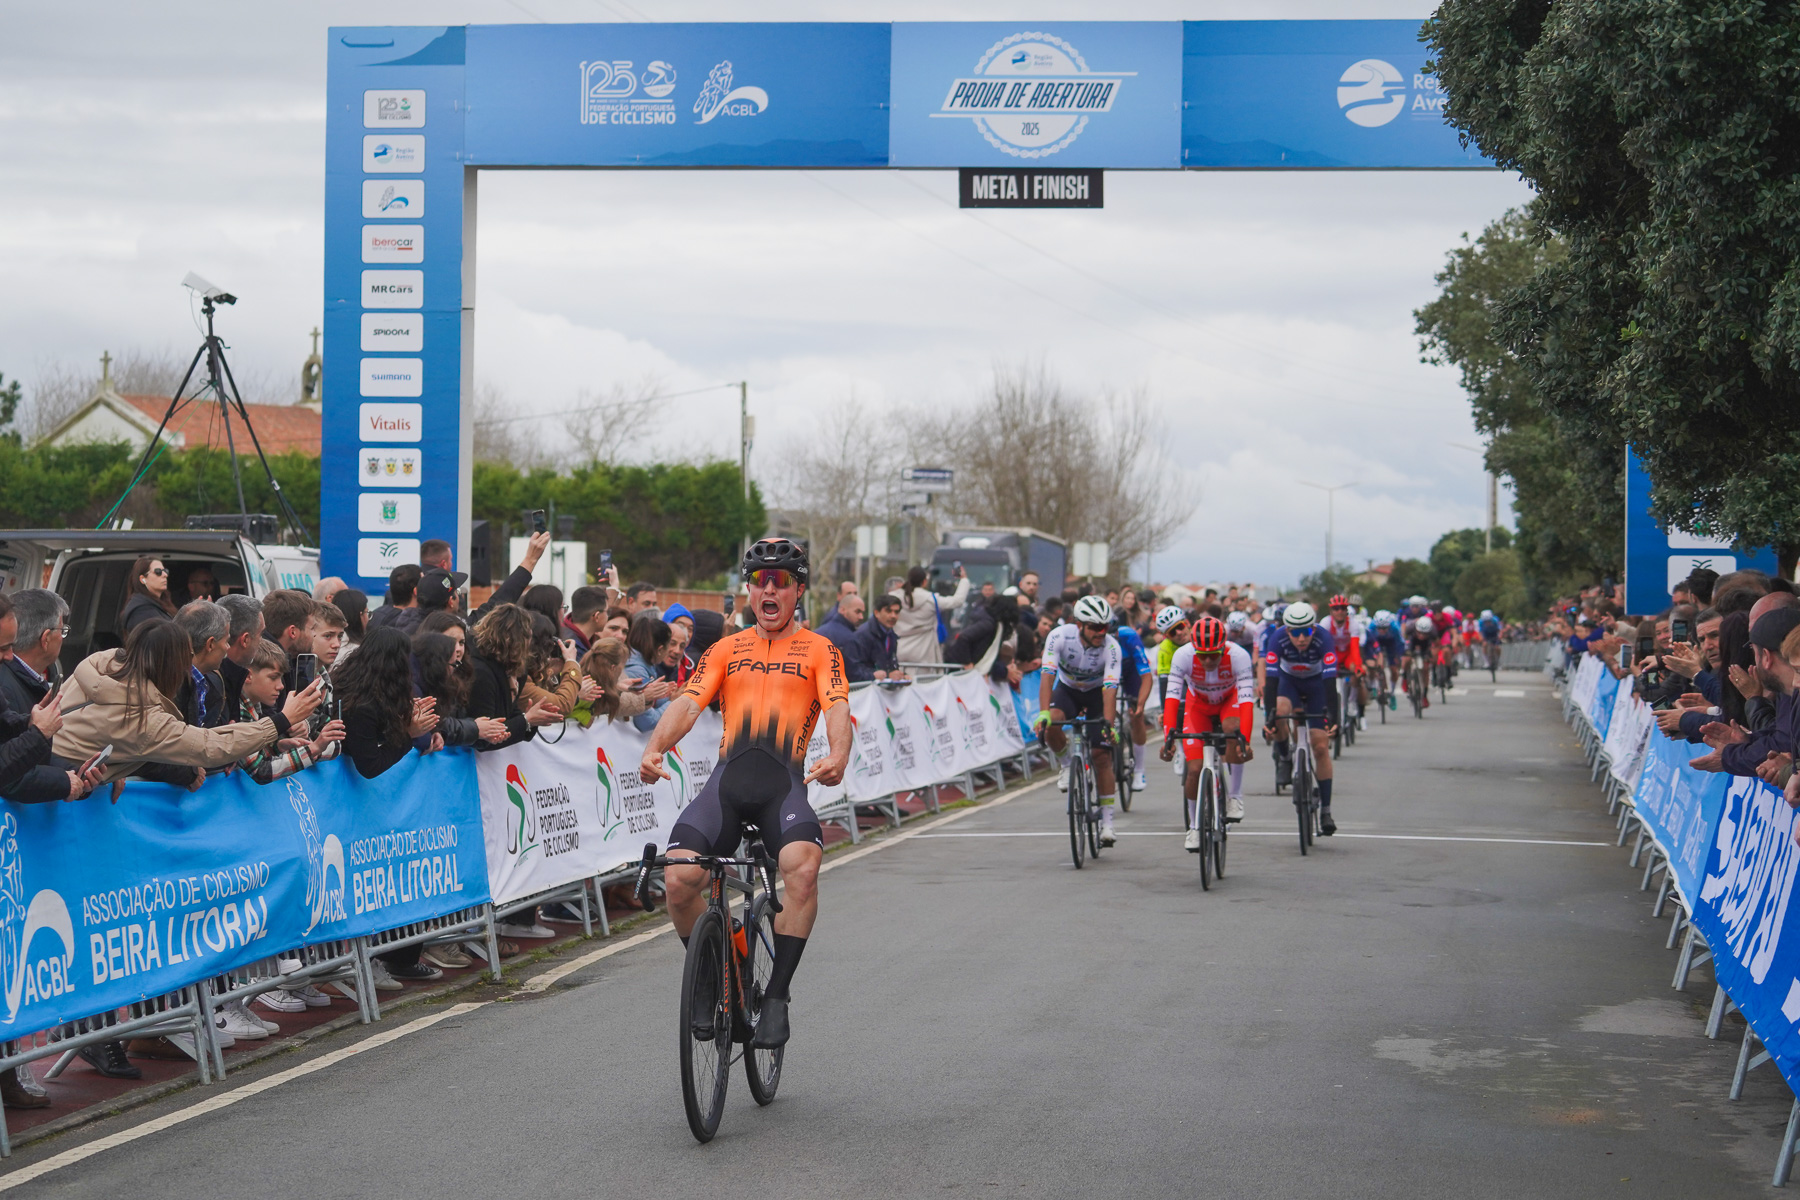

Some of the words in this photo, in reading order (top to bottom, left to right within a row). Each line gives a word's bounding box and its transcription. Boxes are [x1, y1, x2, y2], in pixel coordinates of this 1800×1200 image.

[589, 104, 629, 112] FEDERAÇÃO
[630, 104, 675, 112] PORTUGUESA
[949, 82, 1007, 108] PROVA
[1004, 82, 1031, 108] DE
[1027, 82, 1115, 108] ABERTURA
[1411, 94, 1448, 111] Ave
[589, 112, 607, 124] DE
[611, 112, 676, 124] CICLISMO
[721, 104, 757, 116] ACBL
[1021, 122, 1039, 135] 2025
[972, 175, 1018, 199] META
[1033, 175, 1089, 199] FINISH
[372, 237, 413, 246] iberocar
[370, 415, 411, 431] Vitalis
[692, 643, 716, 684] EFAPEL
[727, 658, 809, 680] EFAPEL
[827, 644, 843, 689] EFAPEL
[796, 698, 821, 755] EFAPEL
[535, 783, 570, 810] FEDERAÇÃO
[539, 808, 579, 835] PORTUGUESA
[350, 829, 404, 867] ASSOCIAÇÃO
[406, 831, 417, 855] DE
[418, 824, 458, 853] CICLISMO
[543, 838, 553, 858] DE
[552, 831, 579, 855] CICLISMO
[83, 877, 176, 927] ASSOCIAÇÃO
[179, 877, 201, 906] DE
[203, 861, 270, 901] CICLISMO
[353, 865, 398, 915] BEIRA
[400, 853, 463, 903] LITORAL
[321, 887, 347, 925] ACBL
[90, 920, 162, 985] BEIRA
[167, 896, 268, 965] LITORAL
[25, 954, 75, 1006] ACBL
